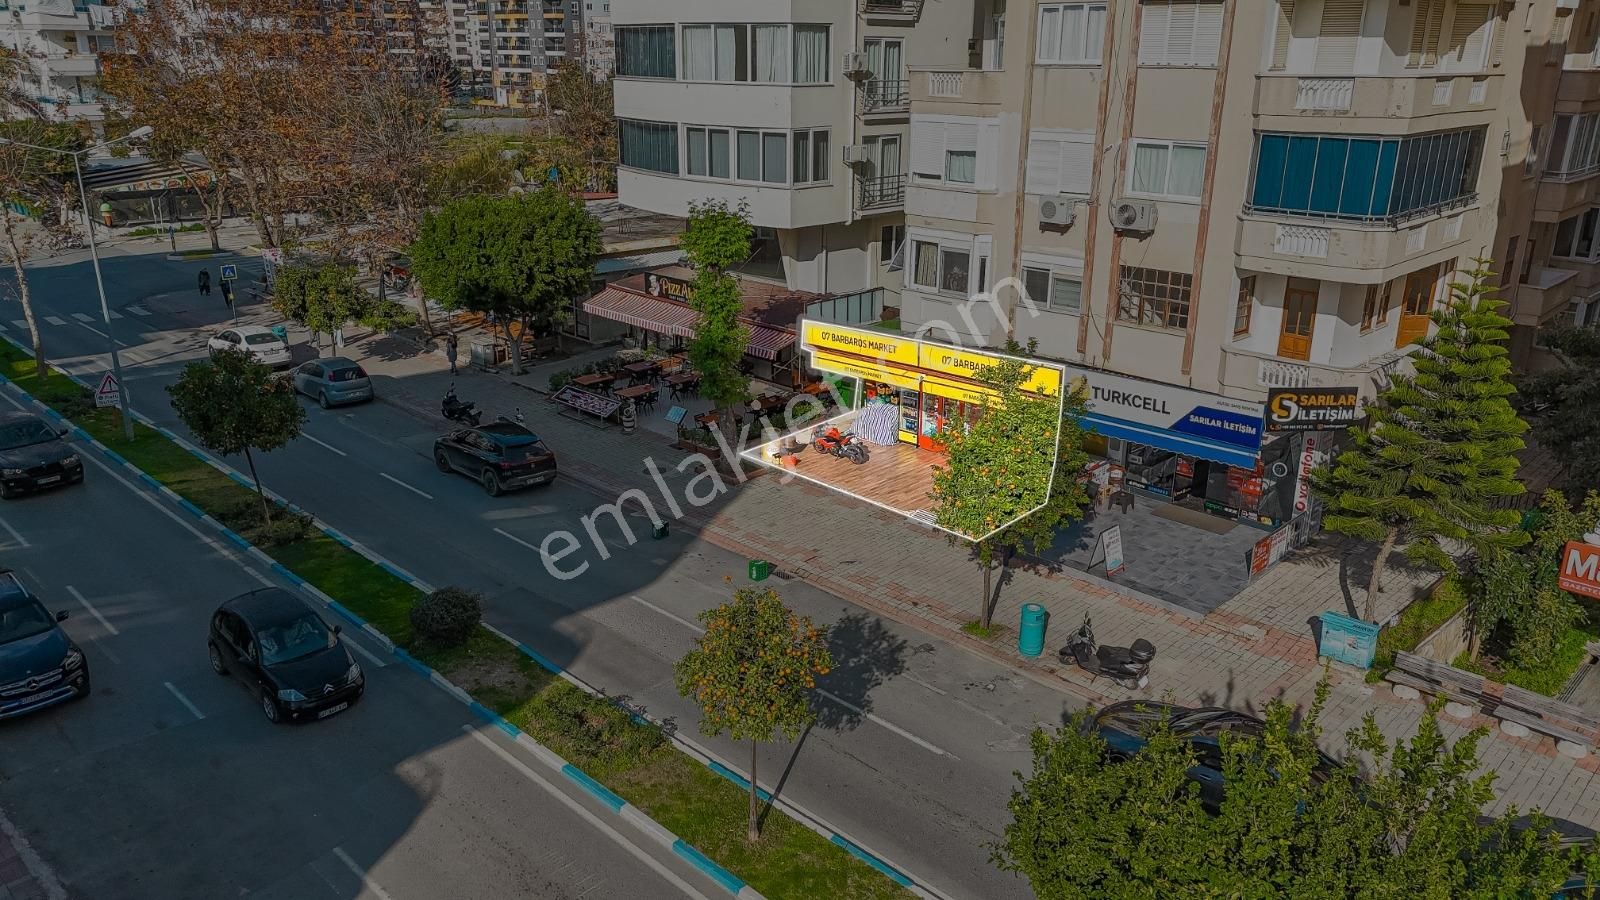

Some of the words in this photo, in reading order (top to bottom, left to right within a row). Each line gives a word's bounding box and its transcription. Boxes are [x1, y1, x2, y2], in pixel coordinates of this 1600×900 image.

[821, 331, 830, 341] 07
[831, 333, 867, 349] BARBAROS
[869, 340, 897, 354] MARKET
[941, 355, 951, 366] 07
[1091, 385, 1171, 415] TURKCELL
[1299, 394, 1357, 406] SARILAR
[1189, 414, 1222, 428] SARILAR
[1223, 419, 1257, 436] İLETİŞİM
[1297, 406, 1353, 422] İLETİŞİM
[1298, 437, 1315, 499] vodafone
[1565, 548, 1600, 582] M
